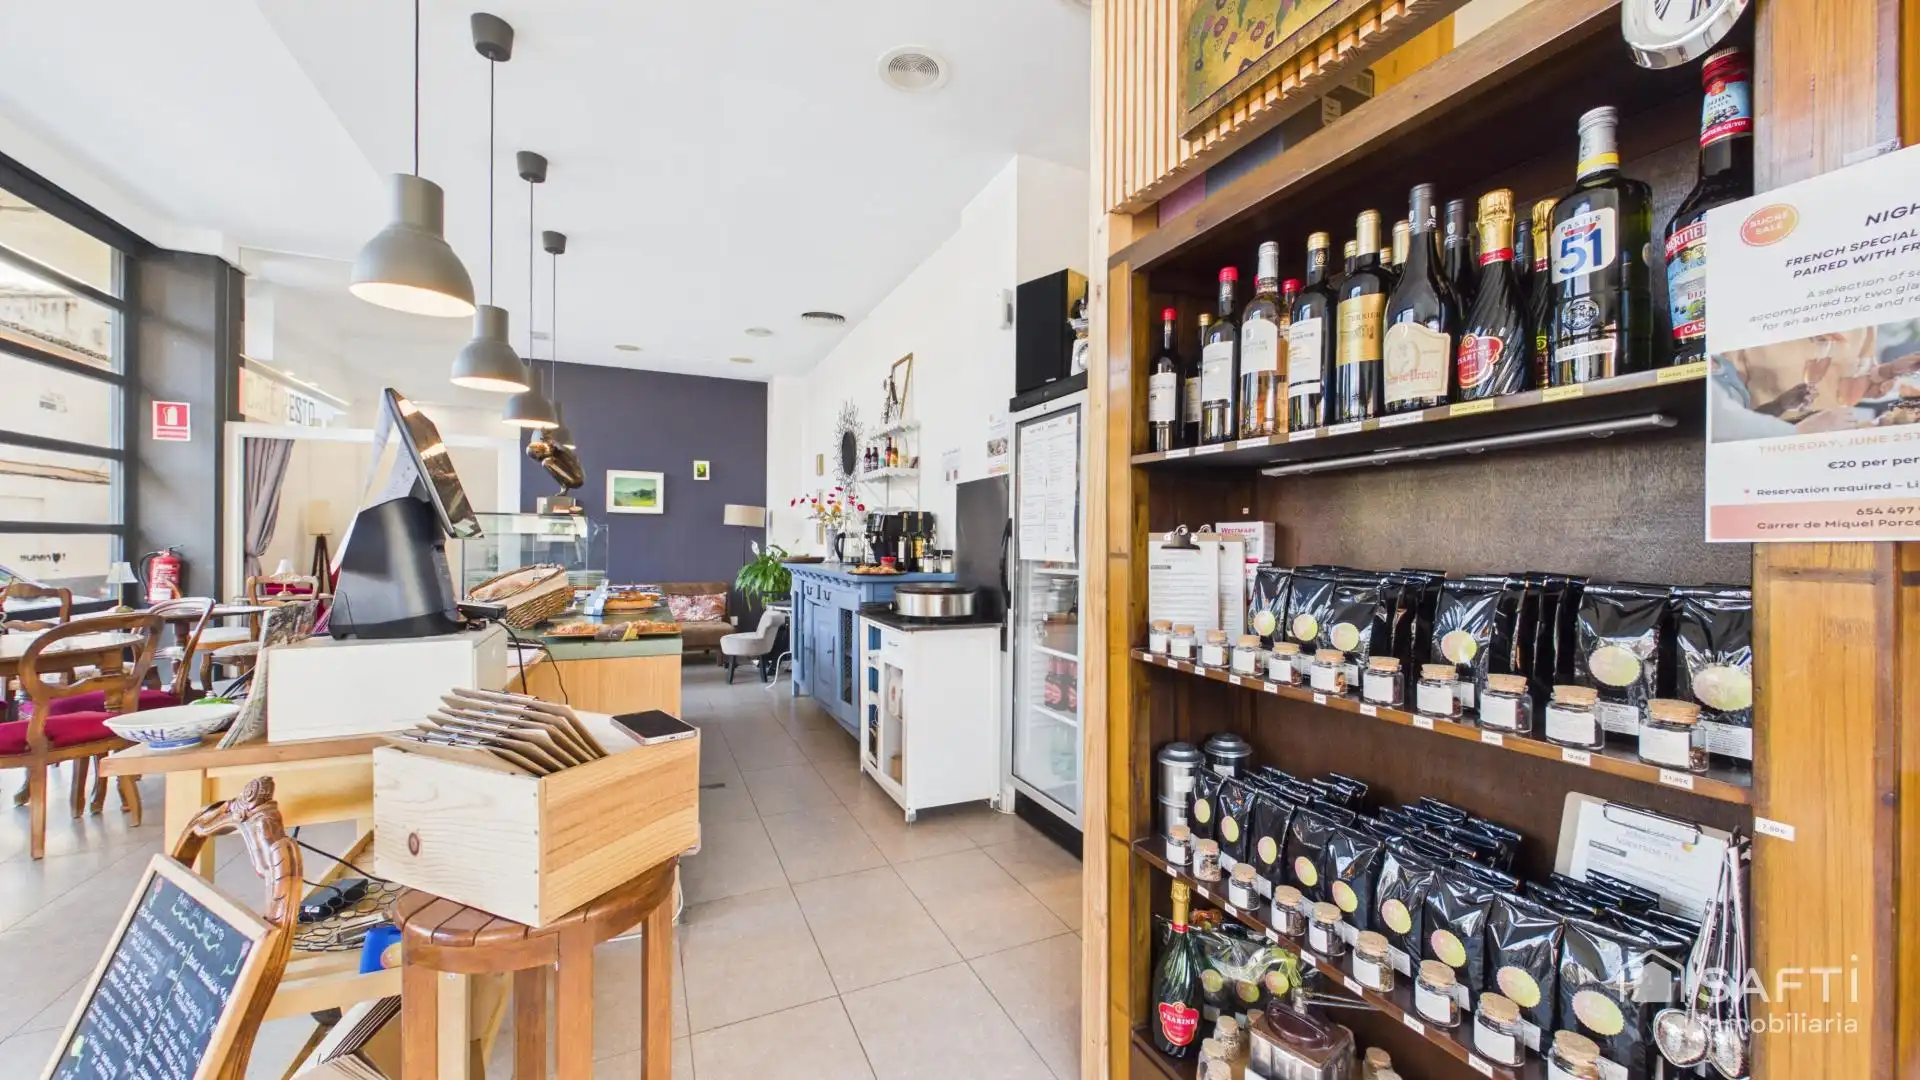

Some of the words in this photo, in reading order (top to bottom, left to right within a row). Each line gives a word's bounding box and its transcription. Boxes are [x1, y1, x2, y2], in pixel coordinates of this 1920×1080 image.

[1561, 215, 1601, 232] PASTIS
[1559, 227, 1602, 274] 51
[1785, 245, 1846, 268] FRENCH
[1793, 259, 1848, 279] PAIRED
[1852, 248, 1896, 266] WITH
[1806, 290, 1816, 299] A
[1818, 276, 1885, 297] selection
[1888, 269, 1906, 282] of
[1749, 297, 1842, 323] accompanied
[1844, 292, 1863, 305] by
[1864, 287, 1893, 299] two
[1762, 319, 1781, 332] for
[1783, 316, 1800, 327] an
[1802, 302, 1871, 324] authentic
[1874, 296, 1904, 311] and
[1758, 440, 1844, 456] THURSDAY,
[1849, 434, 1889, 447] JUNE
[1827, 459, 1857, 470] €20
[1861, 457, 1888, 469] per
[1892, 456, 1920, 467] per
[1757, 486, 1830, 496] Reservation
[1833, 481, 1892, 493] required
[1856, 507, 1884, 516] 654
[1887, 506, 1914, 515] 497
[1757, 522, 1800, 530] Carrer
[1803, 520, 1821, 529] de
[1824, 519, 1875, 531] Miquel
